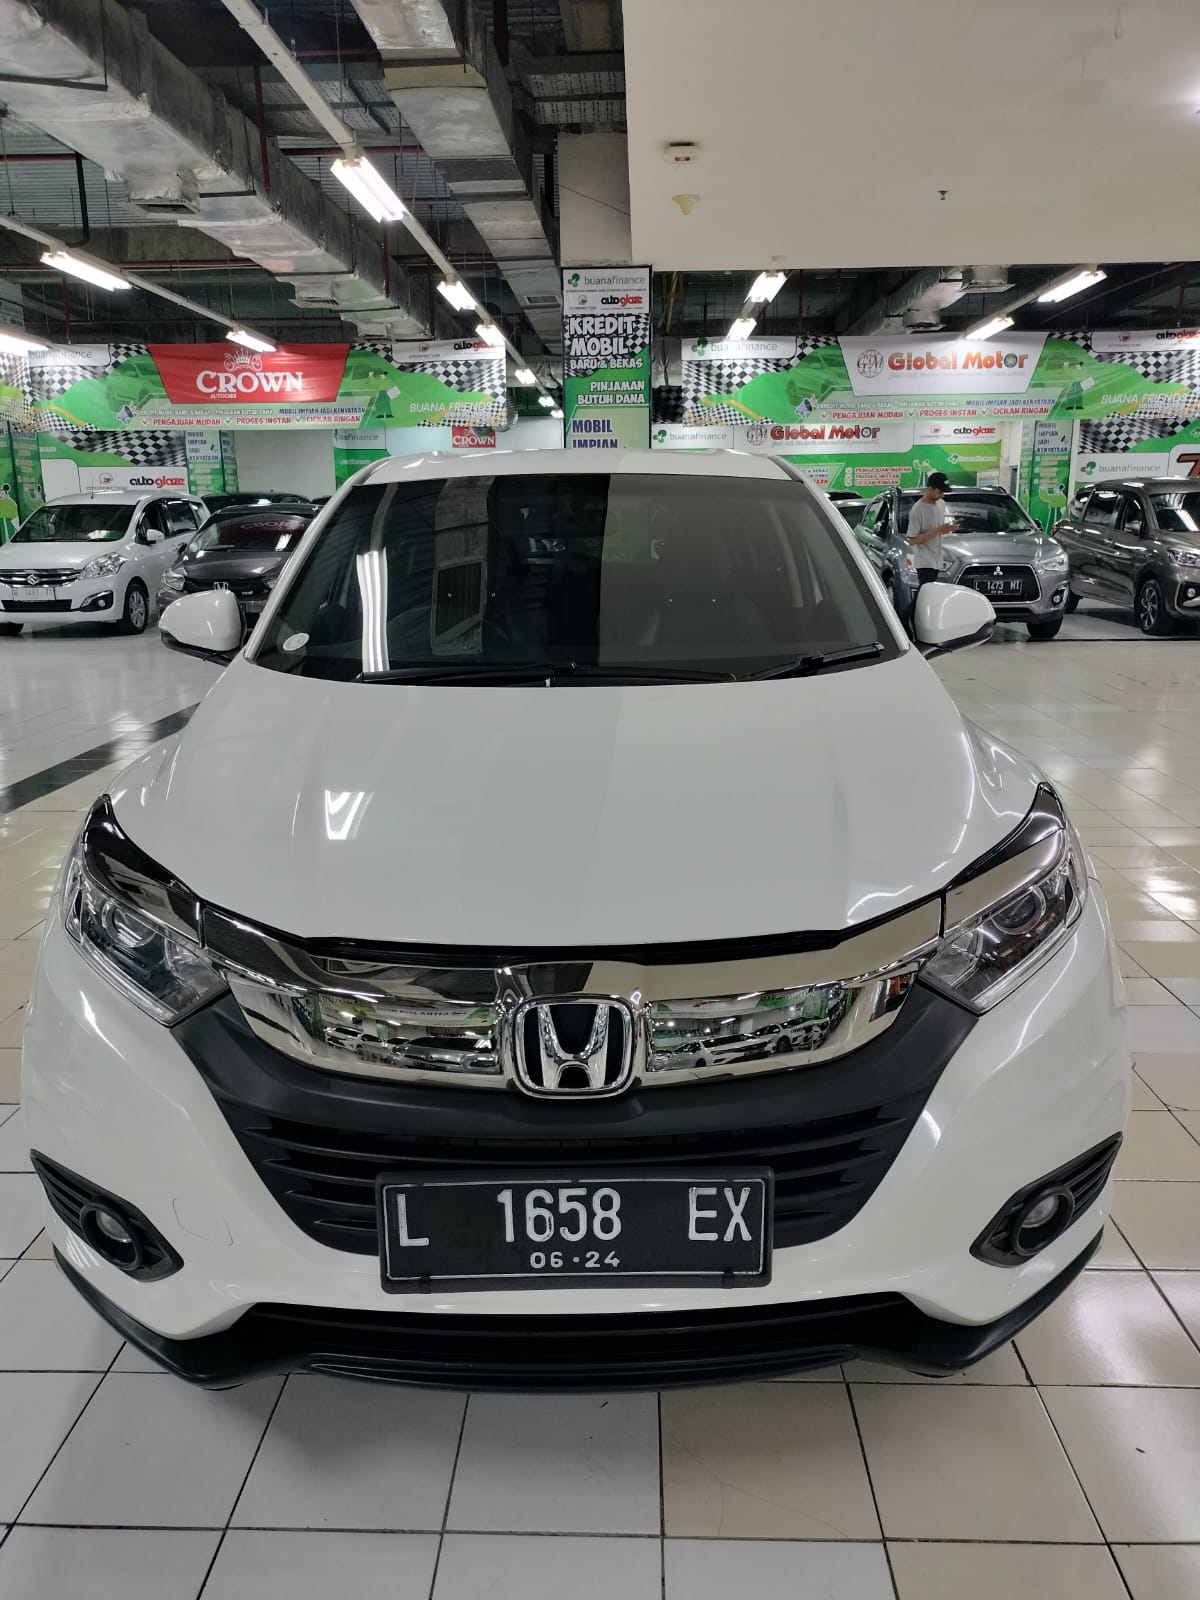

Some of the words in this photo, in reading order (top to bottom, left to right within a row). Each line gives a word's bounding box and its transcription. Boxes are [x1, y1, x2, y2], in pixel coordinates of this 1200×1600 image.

[584, 275, 646, 286] buanafinance
[569, 317, 636, 335] KREDIT
[570, 337, 629, 356] MOBIL
[570, 359, 597, 369] BARU
[610, 358, 643, 369] BEKAS
[888, 353, 957, 371] Global
[962, 351, 1028, 369] Motor
[196, 370, 304, 393] CROWN
[590, 381, 645, 392] PINJAMAN
[578, 395, 614, 404] BUTUH
[615, 394, 645, 404] DANA
[1101, 394, 1137, 404] BUANA
[409, 403, 445, 412] BUANA
[572, 420, 612, 433] MOBIL
[670, 432, 727, 440] buanafinance
[771, 426, 825, 440] Global
[828, 425, 880, 439] Motor
[453, 436, 495, 446] CROWN
[1099, 464, 1160, 473] buanafinance
[397, 1193, 430, 1247] L
[497, 1187, 622, 1243] 1658
[688, 1187, 753, 1242] EX
